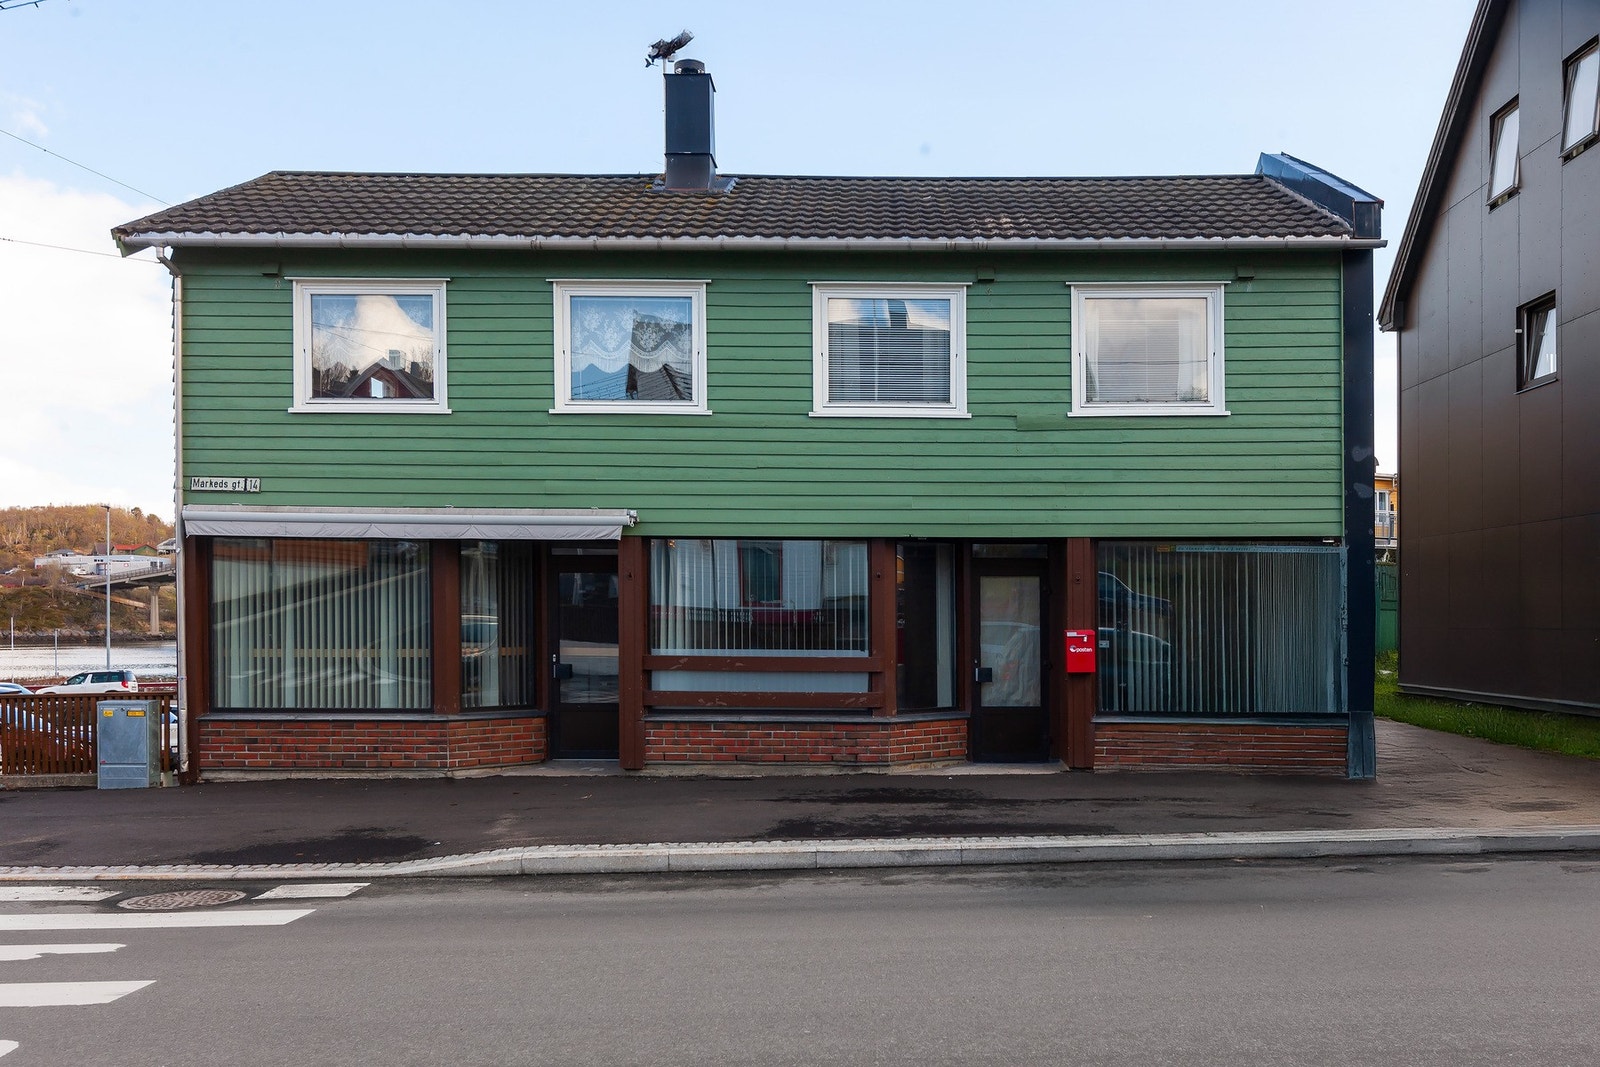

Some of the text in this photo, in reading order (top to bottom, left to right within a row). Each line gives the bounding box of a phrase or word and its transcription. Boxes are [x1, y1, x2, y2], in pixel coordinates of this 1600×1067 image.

[192, 478, 258, 491] Markeds gt. 14
